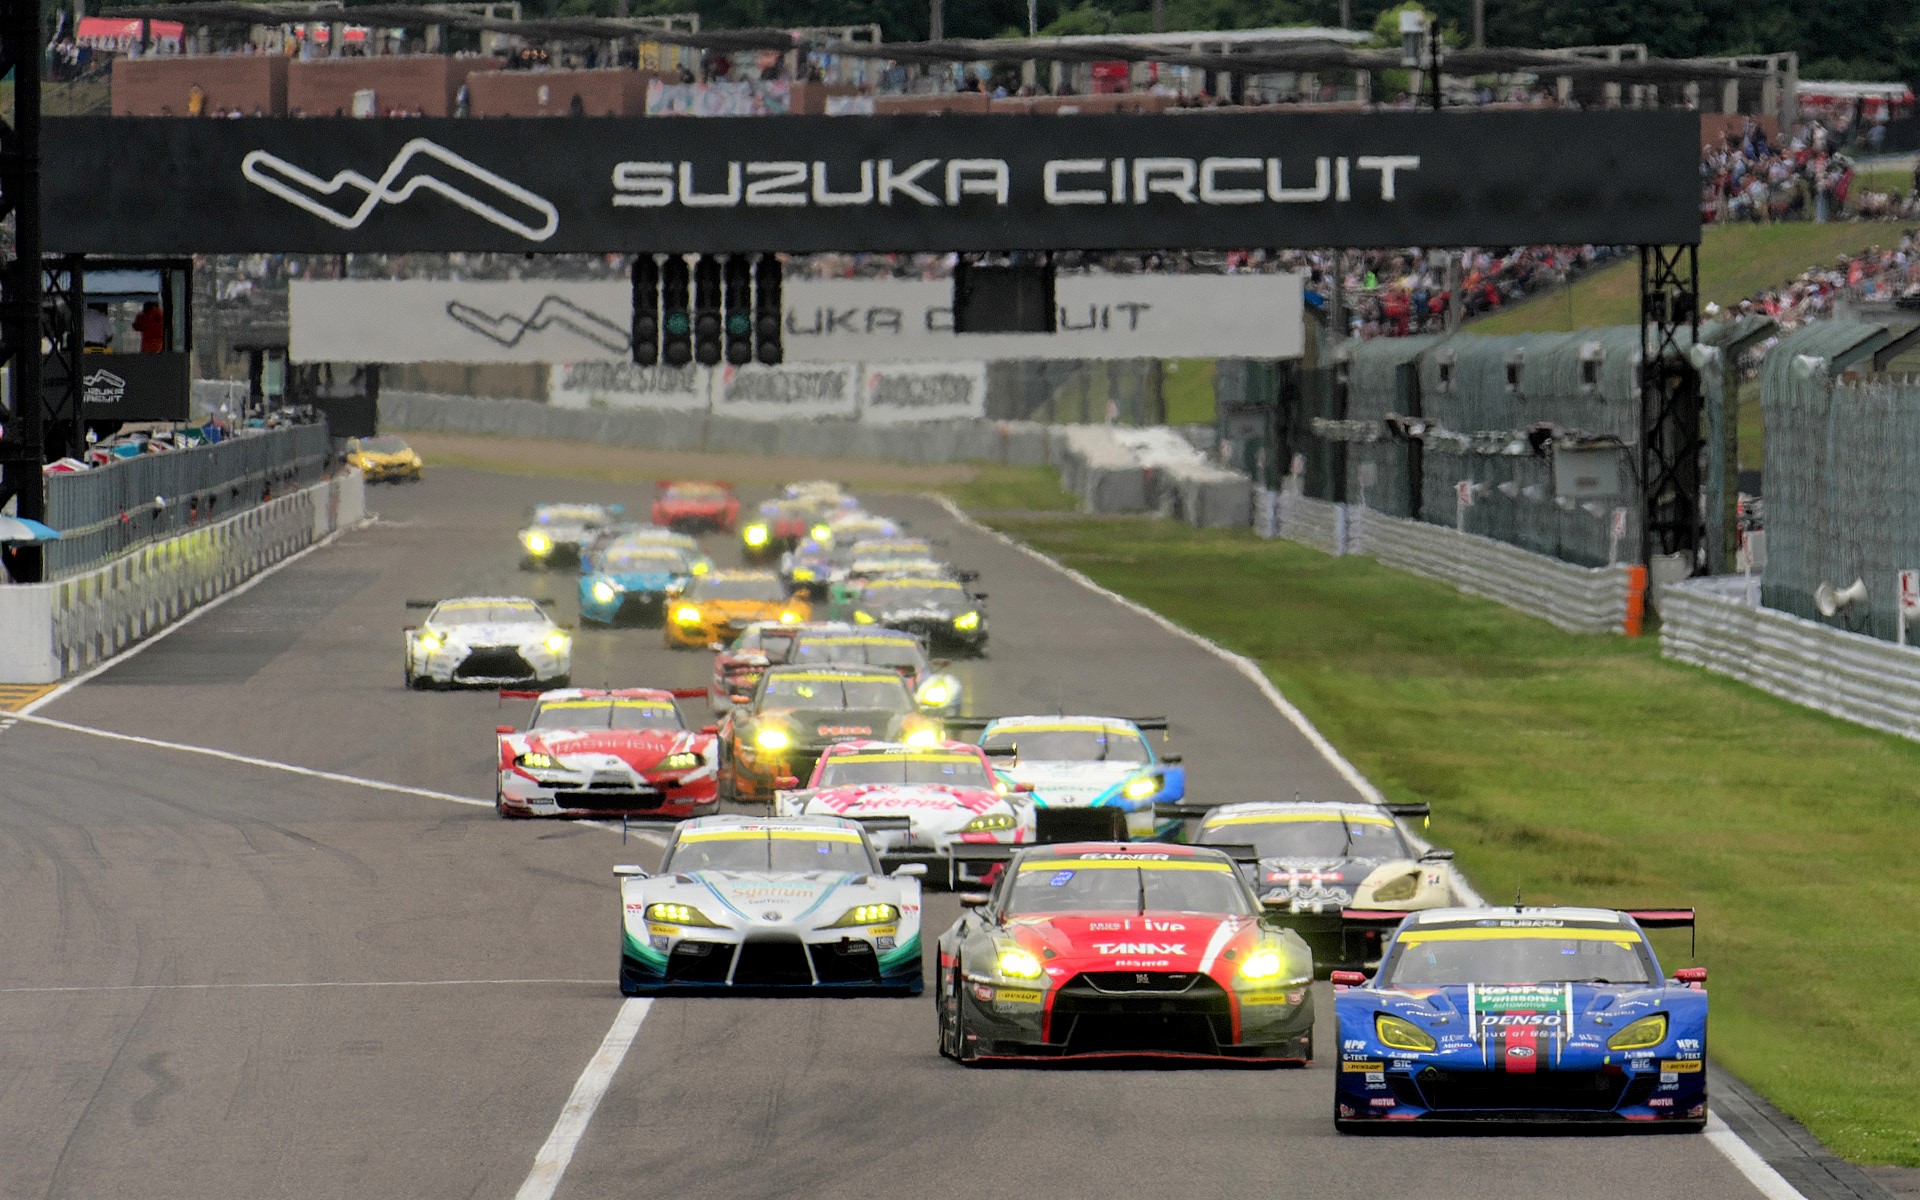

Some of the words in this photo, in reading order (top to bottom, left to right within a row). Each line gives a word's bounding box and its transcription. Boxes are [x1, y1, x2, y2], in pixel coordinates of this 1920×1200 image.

[611, 158, 1010, 207] SUZUKA
[1043, 155, 1421, 204] CIRCUIT
[785, 307, 904, 335] UKA
[925, 302, 1151, 332] CUIT
[1500, 919, 1564, 928] SUBARU
[1004, 992, 1038, 1000] DUNLOP
[1481, 995, 1558, 1004] Panasonic
[1481, 1015, 1562, 1026] DENSO
[1343, 1040, 1367, 1050] NPR
[1676, 1039, 1700, 1049] NPR
[1369, 1098, 1395, 1106] MOTUL
[1648, 1098, 1673, 1106] MOTUL
